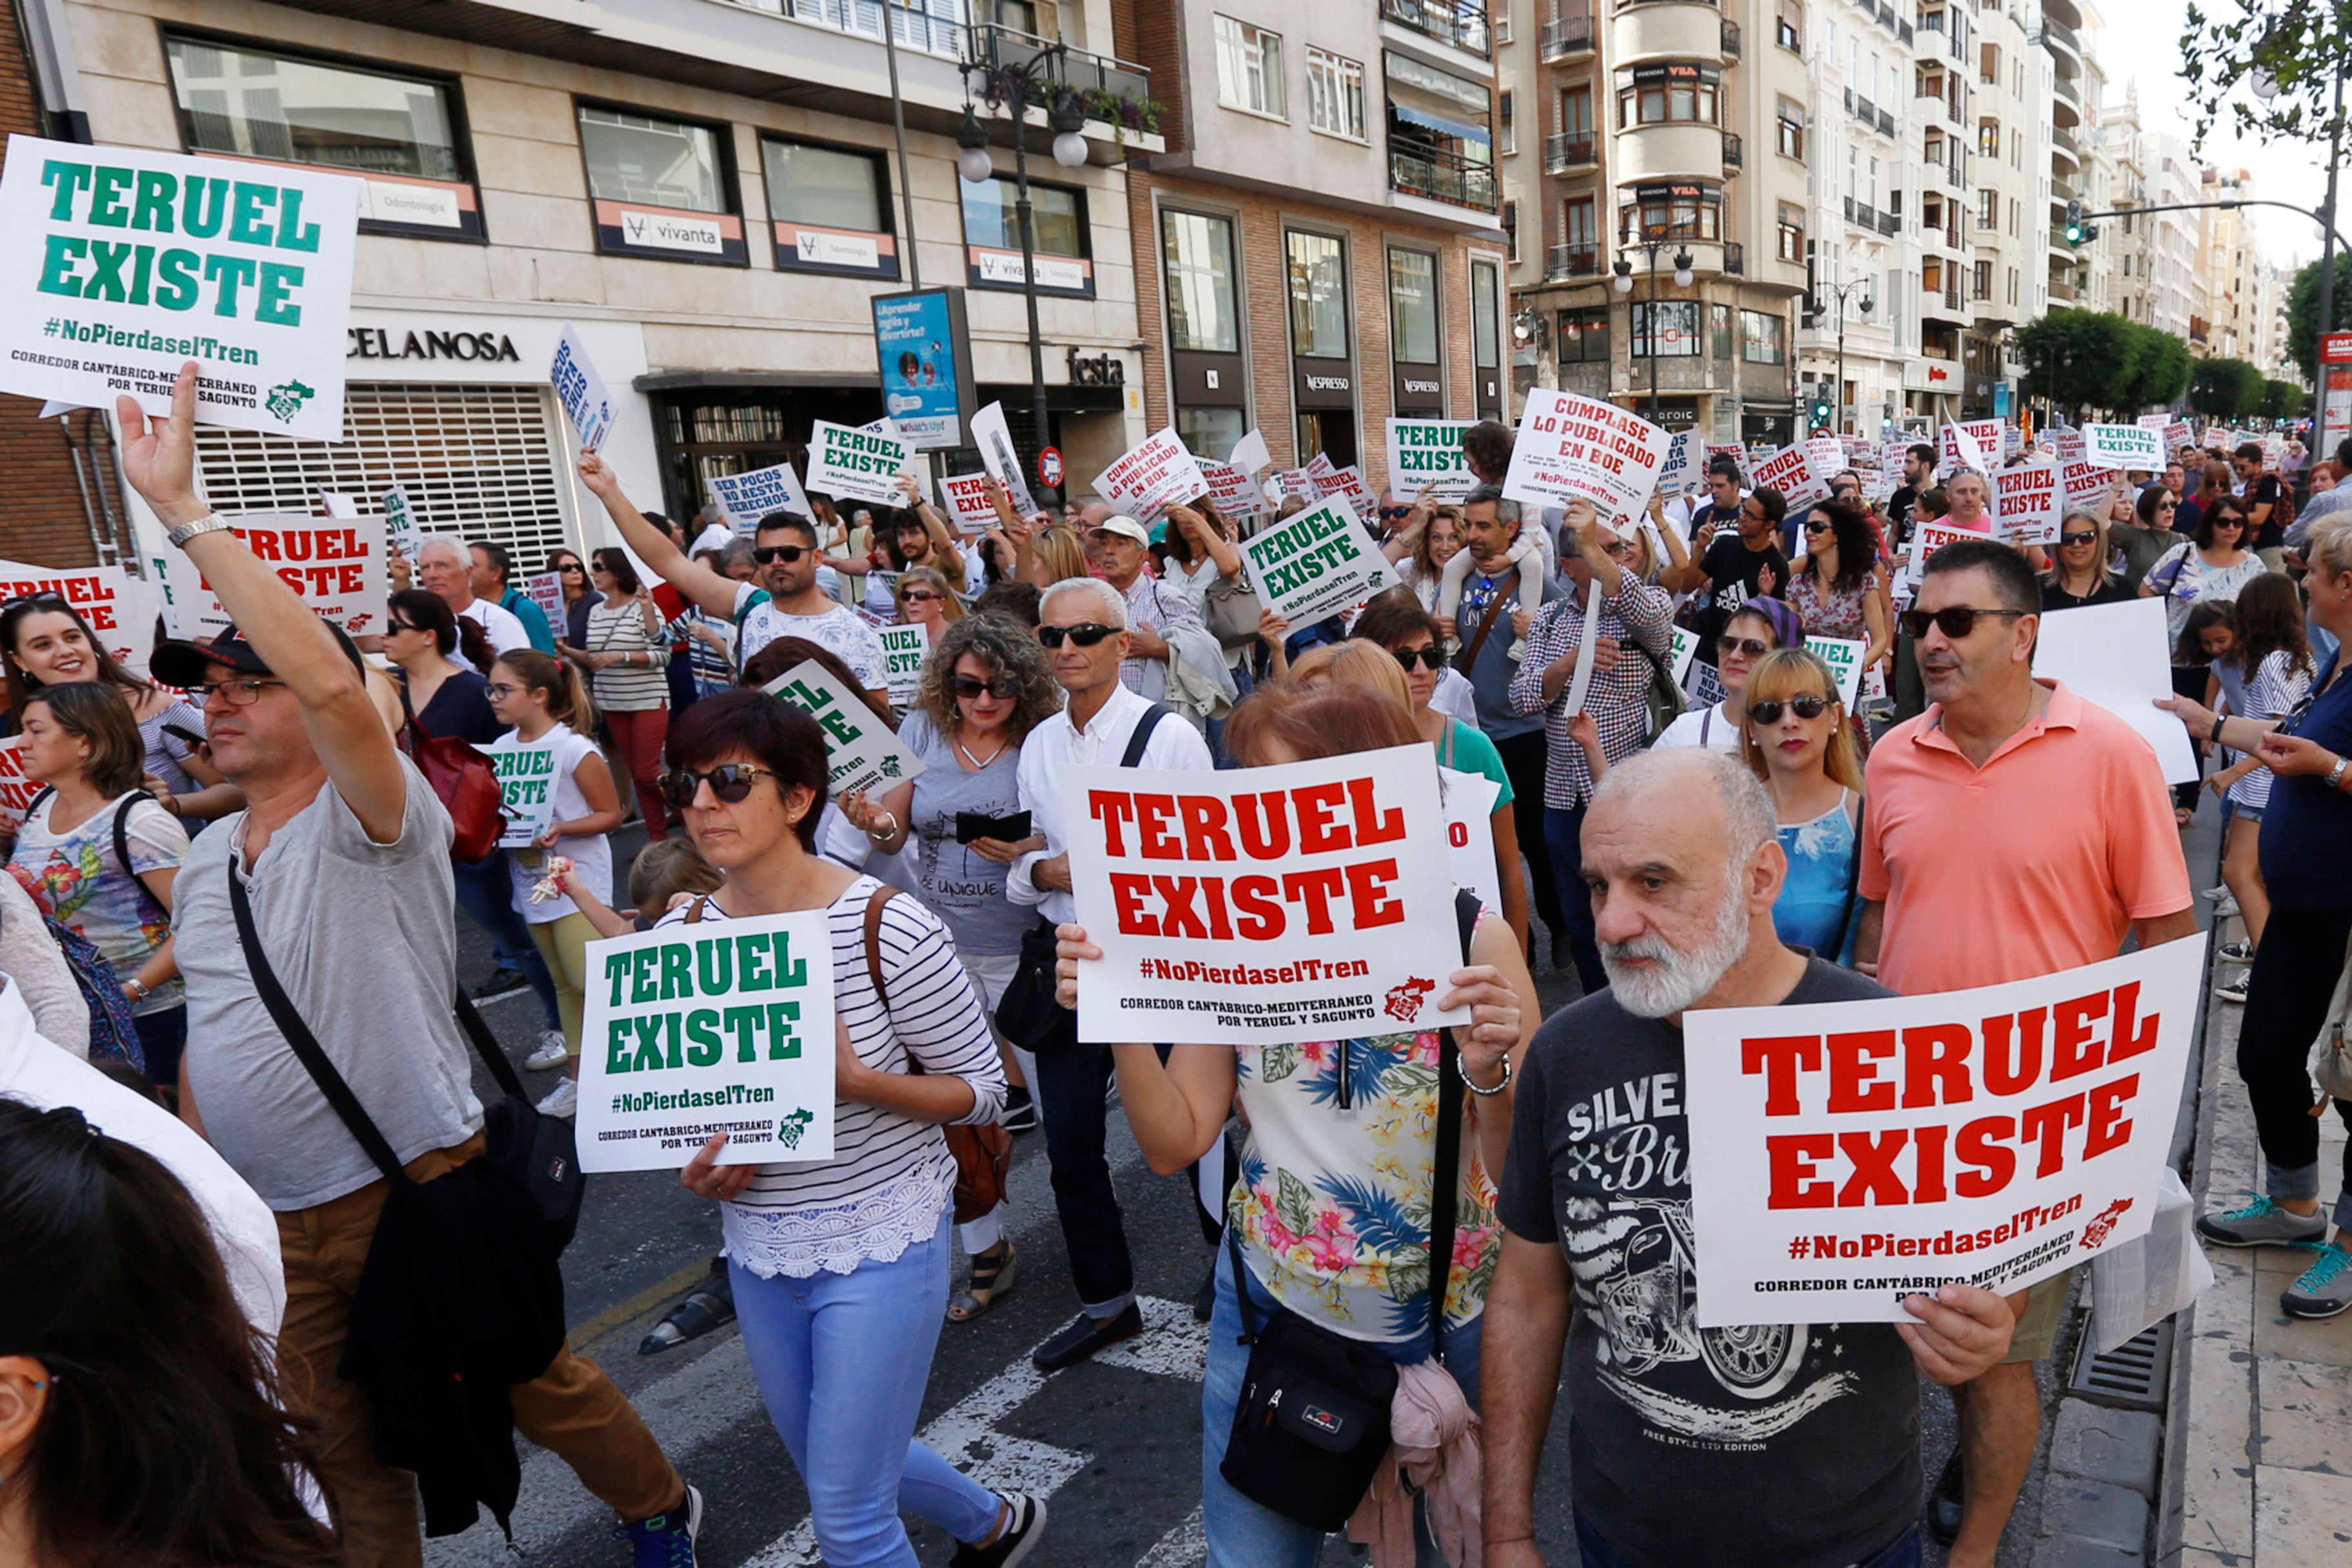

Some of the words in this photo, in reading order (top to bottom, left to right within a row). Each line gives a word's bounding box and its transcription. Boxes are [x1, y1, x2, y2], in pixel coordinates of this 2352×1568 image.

[41, 159, 322, 253] TERUEL
[658, 224, 716, 244] vivanta
[37, 234, 305, 327] EXISTE
[43, 318, 259, 365] #NoPierdaselTren
[11, 349, 79, 370] CORREDOR
[1065, 346, 1126, 385] festa
[107, 378, 130, 391] POR
[135, 382, 173, 396] TERUE
[199, 391, 257, 408] SAGUNTO
[1305, 373, 1349, 391] NESPRESSO
[1404, 378, 1439, 394] NESPRESSO
[824, 427, 905, 460] TERUEL
[1533, 416, 1556, 433] LO
[1560, 420, 1656, 469] PUBLICADO
[2094, 427, 2157, 442] TERUEL
[2098, 439, 2156, 453] EXISTE
[824, 447, 900, 477] EXISTE
[1108, 485, 1122, 500] LO
[1121, 445, 1179, 490] PUBLICADO
[1400, 450, 1464, 471] EXIST
[1558, 440, 1585, 458] EN
[1589, 448, 1624, 475] BOE
[1753, 449, 1804, 485] TERUEL
[714, 478, 738, 491] SER
[739, 469, 782, 487] POCOS
[722, 491, 739, 502] NO
[740, 481, 783, 500] RESTA
[1130, 485, 1146, 498] EN
[1146, 467, 1169, 487] BOE
[1219, 487, 1237, 497] BOE
[1533, 471, 1618, 505] #NoPierdaselTren
[1997, 469, 2055, 495] TERUEL
[2065, 469, 2115, 494] EXISTE
[727, 492, 790, 513] DERECHOS
[1999, 492, 2052, 516] EXISTE
[1248, 507, 1347, 571] TERUEL
[1263, 533, 1360, 600] EXISTE
[1701, 676, 1715, 691] NO
[1088, 776, 1406, 861] TERUEL
[938, 880, 999, 897] UNIQUE
[1109, 857, 1405, 941] EXISTE
[605, 931, 807, 1007] TERUEL
[1140, 958, 1369, 985] #NoPierdaselTren
[1120, 997, 1184, 1010] CORREDOR
[1188, 994, 1373, 1014] CANTÁBRICO-MEDITERRÁNEO
[1217, 1014, 1241, 1026] POR
[1244, 1015, 1296, 1028] TERUEL
[1299, 1014, 1308, 1024] Y
[1312, 1007, 1376, 1024] SAGUNTO
[605, 1001, 801, 1075] EXISTE
[1741, 980, 2161, 1116] TERUEL
[612, 1084, 774, 1113] #NoPierdaselTren
[1567, 1072, 1688, 1141] SILVE
[598, 1129, 637, 1141] CORREDOR
[661, 1137, 681, 1149] POR
[732, 1132, 773, 1144] SAGUNTO
[1766, 1072, 2141, 1210] EXISTE
[1602, 1124, 1692, 1191] Br
[1788, 1193, 2082, 1260] #NoPierdaselTren
[1999, 1275, 2008, 1285] Y
[2011, 1244, 2072, 1279] SAGUNTO
[1754, 1279, 1848, 1293] CORREDOR
[1643, 1429, 1665, 1442] FREE
[1668, 1436, 1698, 1449] STYLE
[1701, 1442, 1721, 1451] LTD
[1724, 1443, 1767, 1451] EDITION
